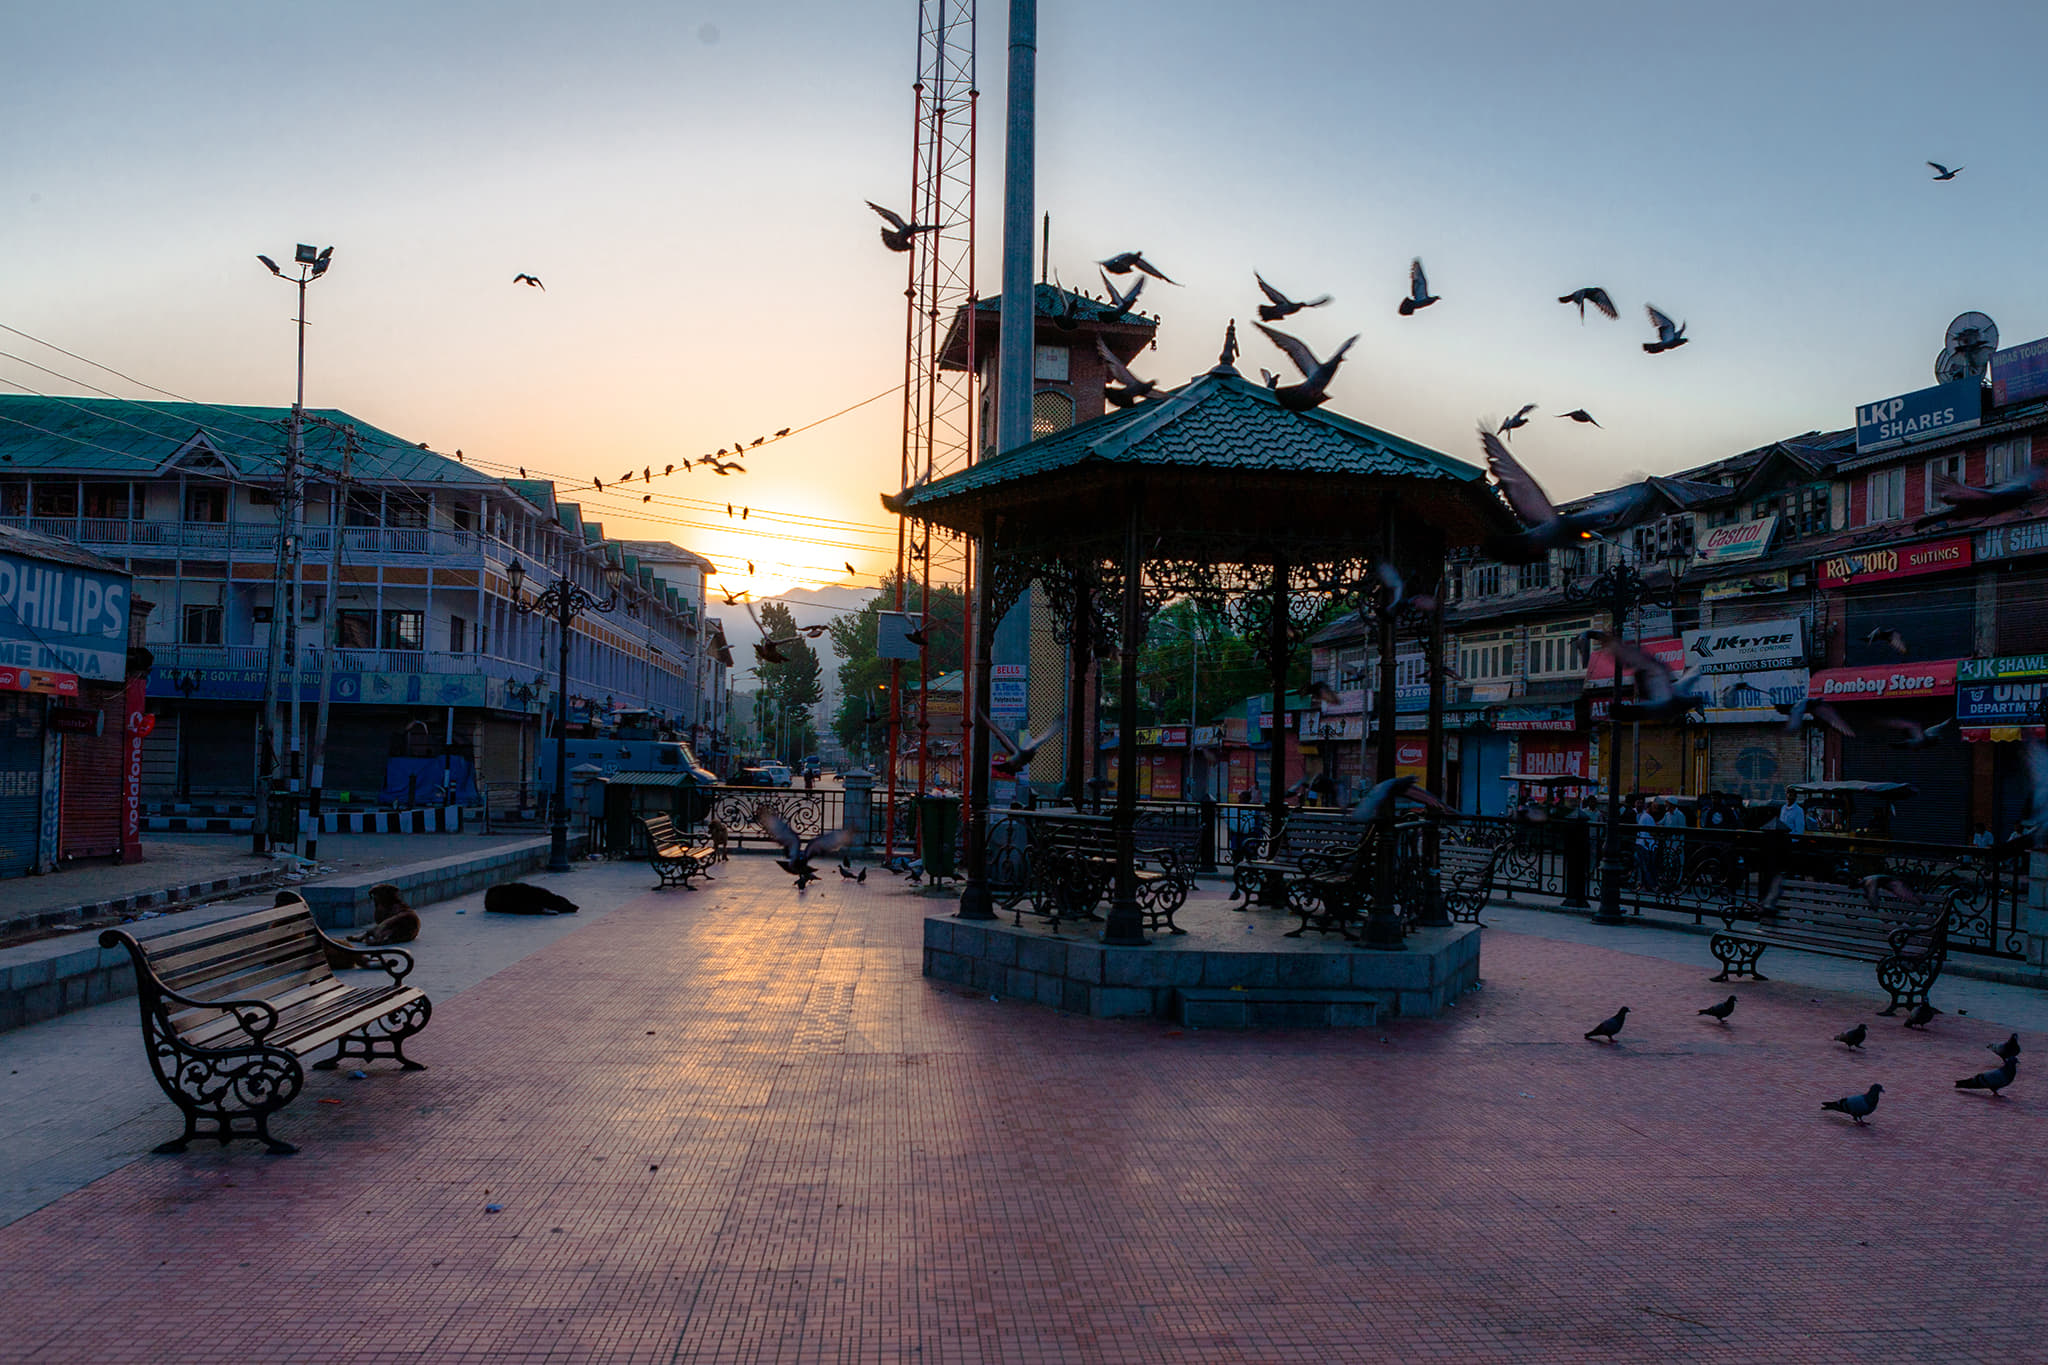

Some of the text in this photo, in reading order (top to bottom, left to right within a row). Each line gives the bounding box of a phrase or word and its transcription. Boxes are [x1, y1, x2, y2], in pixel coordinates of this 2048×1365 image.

[1993, 350, 2018, 368] MIDAS
[1860, 398, 1904, 427] LKP
[1879, 407, 1955, 439] SHARES
[1708, 521, 1765, 548] Castrol
[1977, 527, 2004, 561] JK
[1909, 547, 1960, 567] SUITINGS
[38, 651, 101, 674] INDIA
[997, 665, 1020, 674] BELLS
[1726, 660, 1758, 673] MOTOR
[1760, 657, 1793, 669] STORE
[1974, 656, 2046, 679] JK SHAWL
[1770, 685, 1808, 705] STORE
[1823, 678, 1886, 696] Bombay
[1889, 674, 1935, 691] Store
[1530, 720, 1573, 731] TRAVELS
[1526, 751, 1584, 777] BHARAT
[128, 736, 142, 836] vodafone
[1722, 783, 1786, 801] TATA
